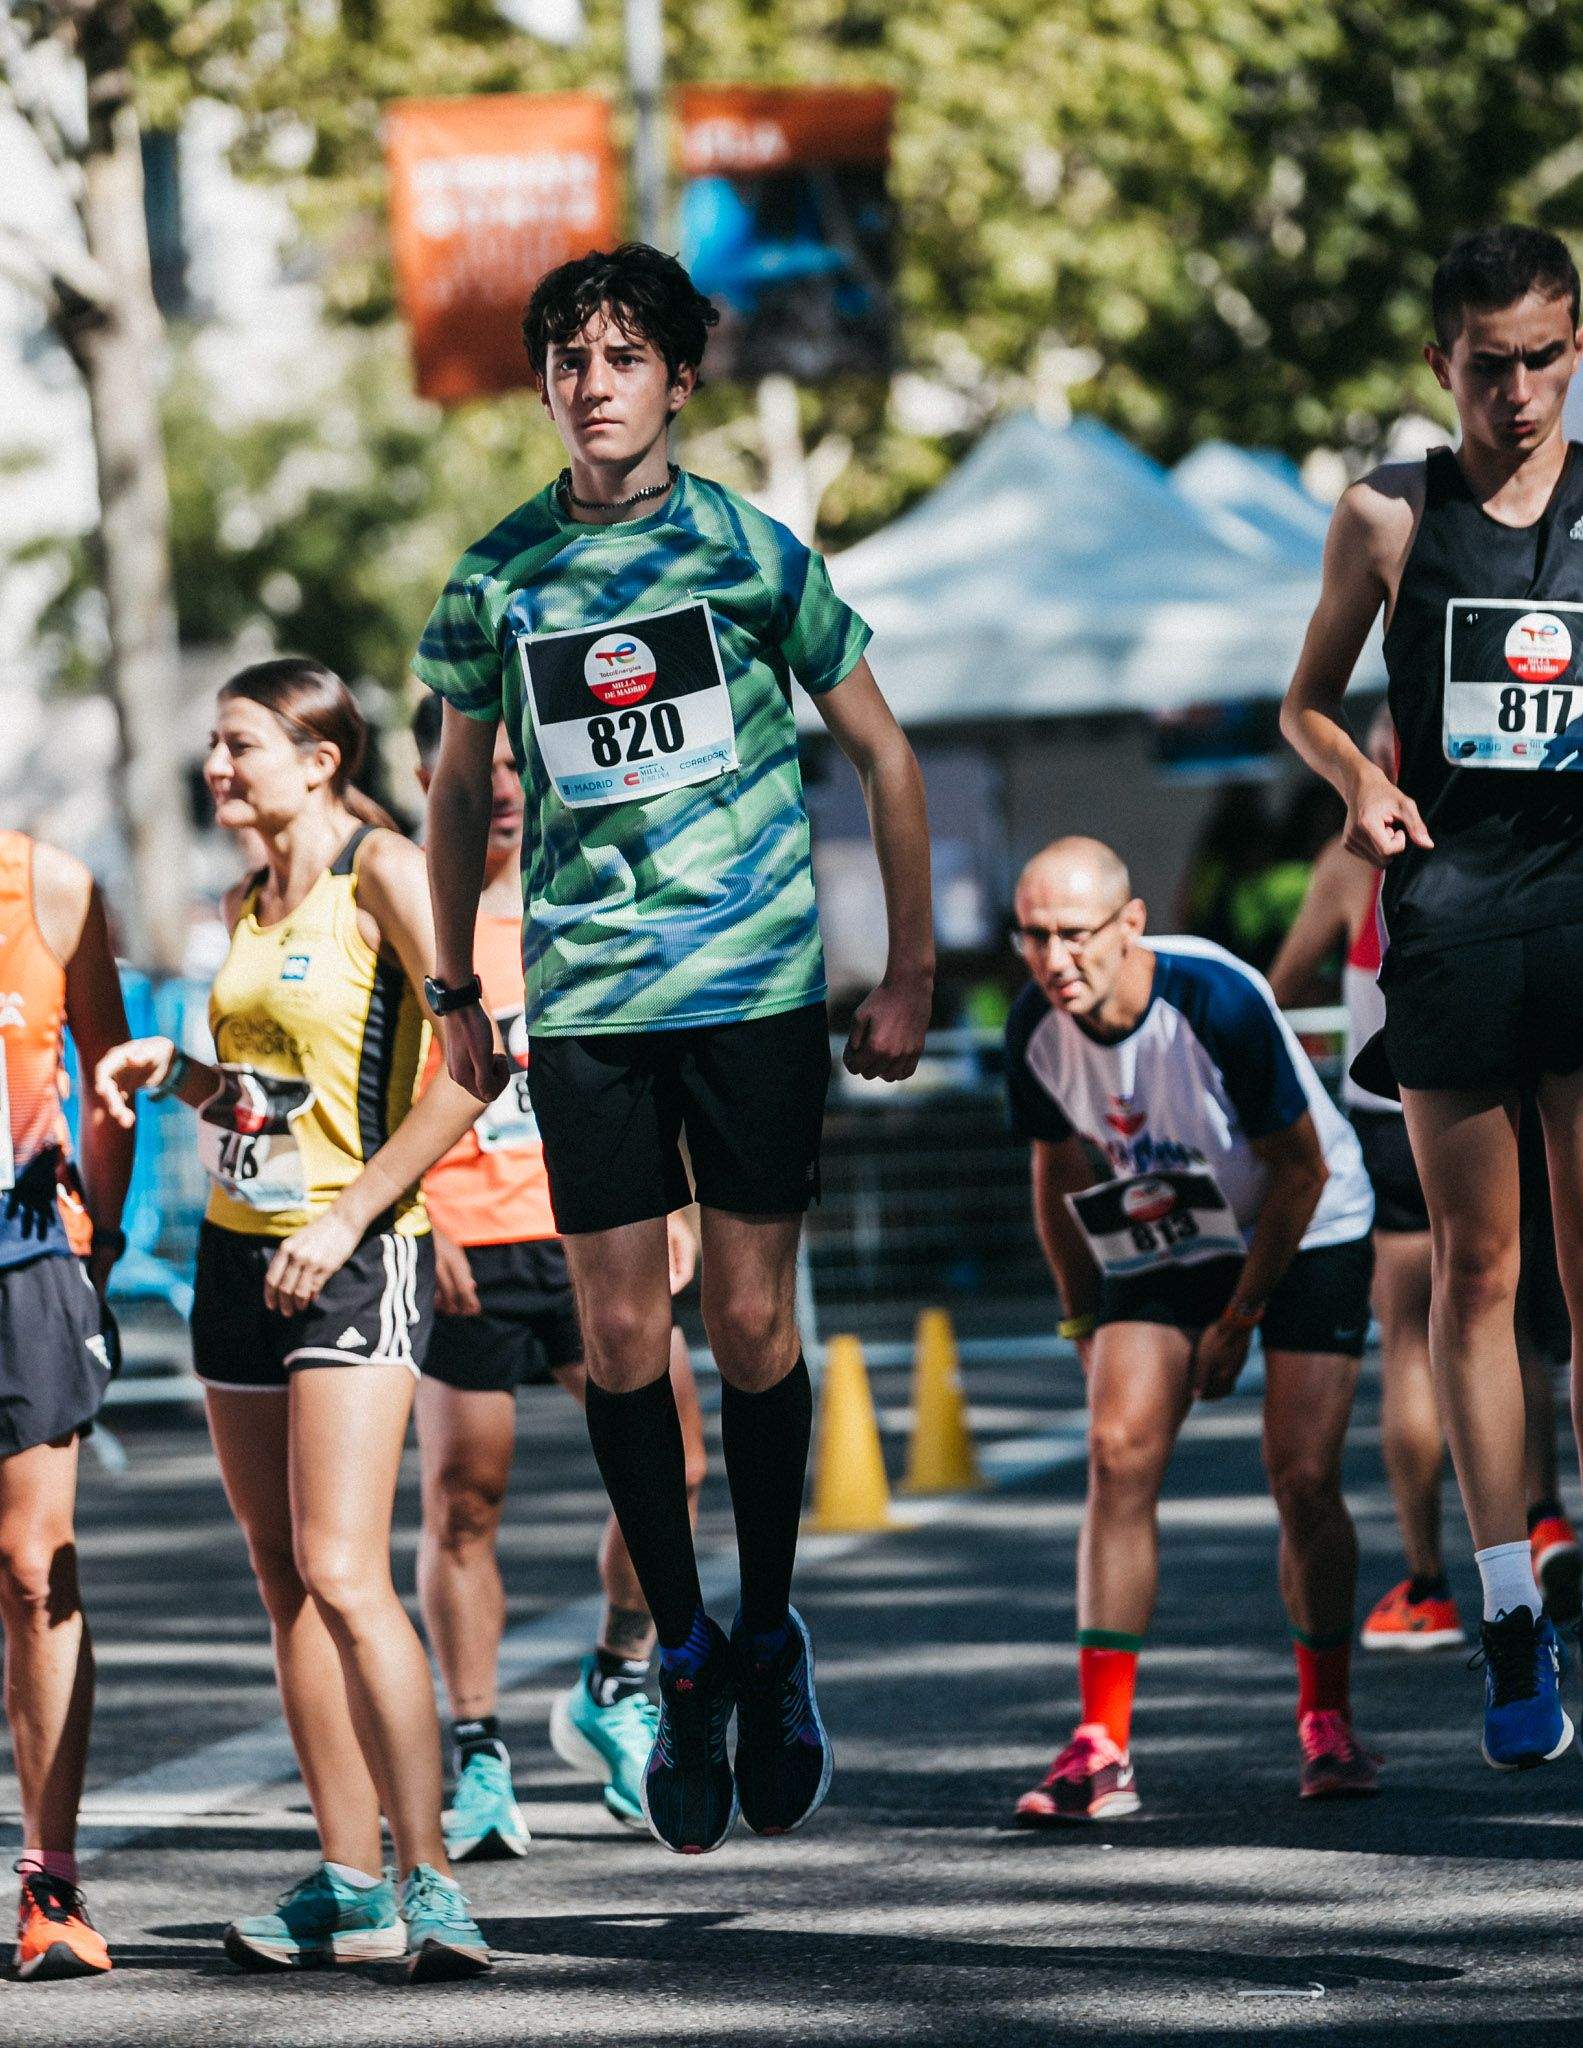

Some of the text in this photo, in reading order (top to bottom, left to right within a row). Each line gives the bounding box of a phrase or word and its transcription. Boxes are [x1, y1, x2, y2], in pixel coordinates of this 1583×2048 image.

[604, 683, 647, 699] DE MADRID
[612, 679, 636, 690] MILLA
[1498, 687, 1573, 735] 817
[587, 703, 684, 767] 820
[1453, 741, 1502, 753] MDRID
[574, 779, 613, 792] MADRID
